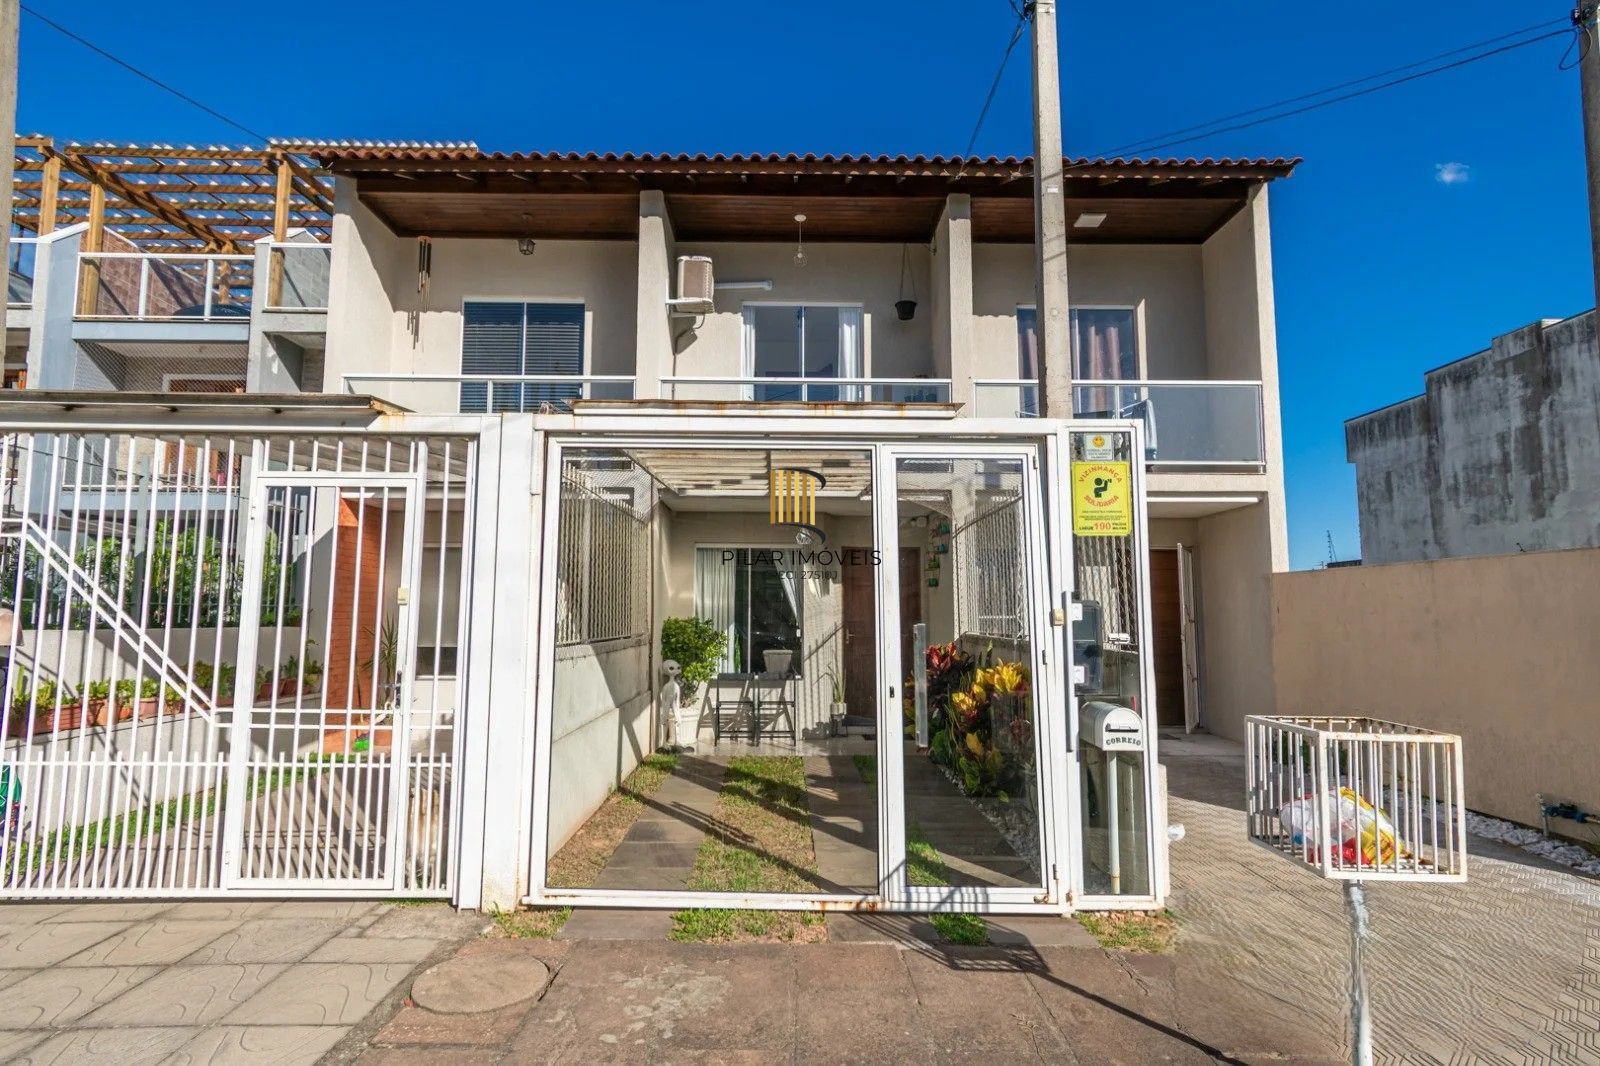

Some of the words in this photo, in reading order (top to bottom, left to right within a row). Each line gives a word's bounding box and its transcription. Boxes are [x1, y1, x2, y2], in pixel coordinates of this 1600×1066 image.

[1079, 465, 1122, 483] VIZINHANÇA
[1094, 522, 1111, 531] 190
[1105, 736, 1142, 746] CORREIO
